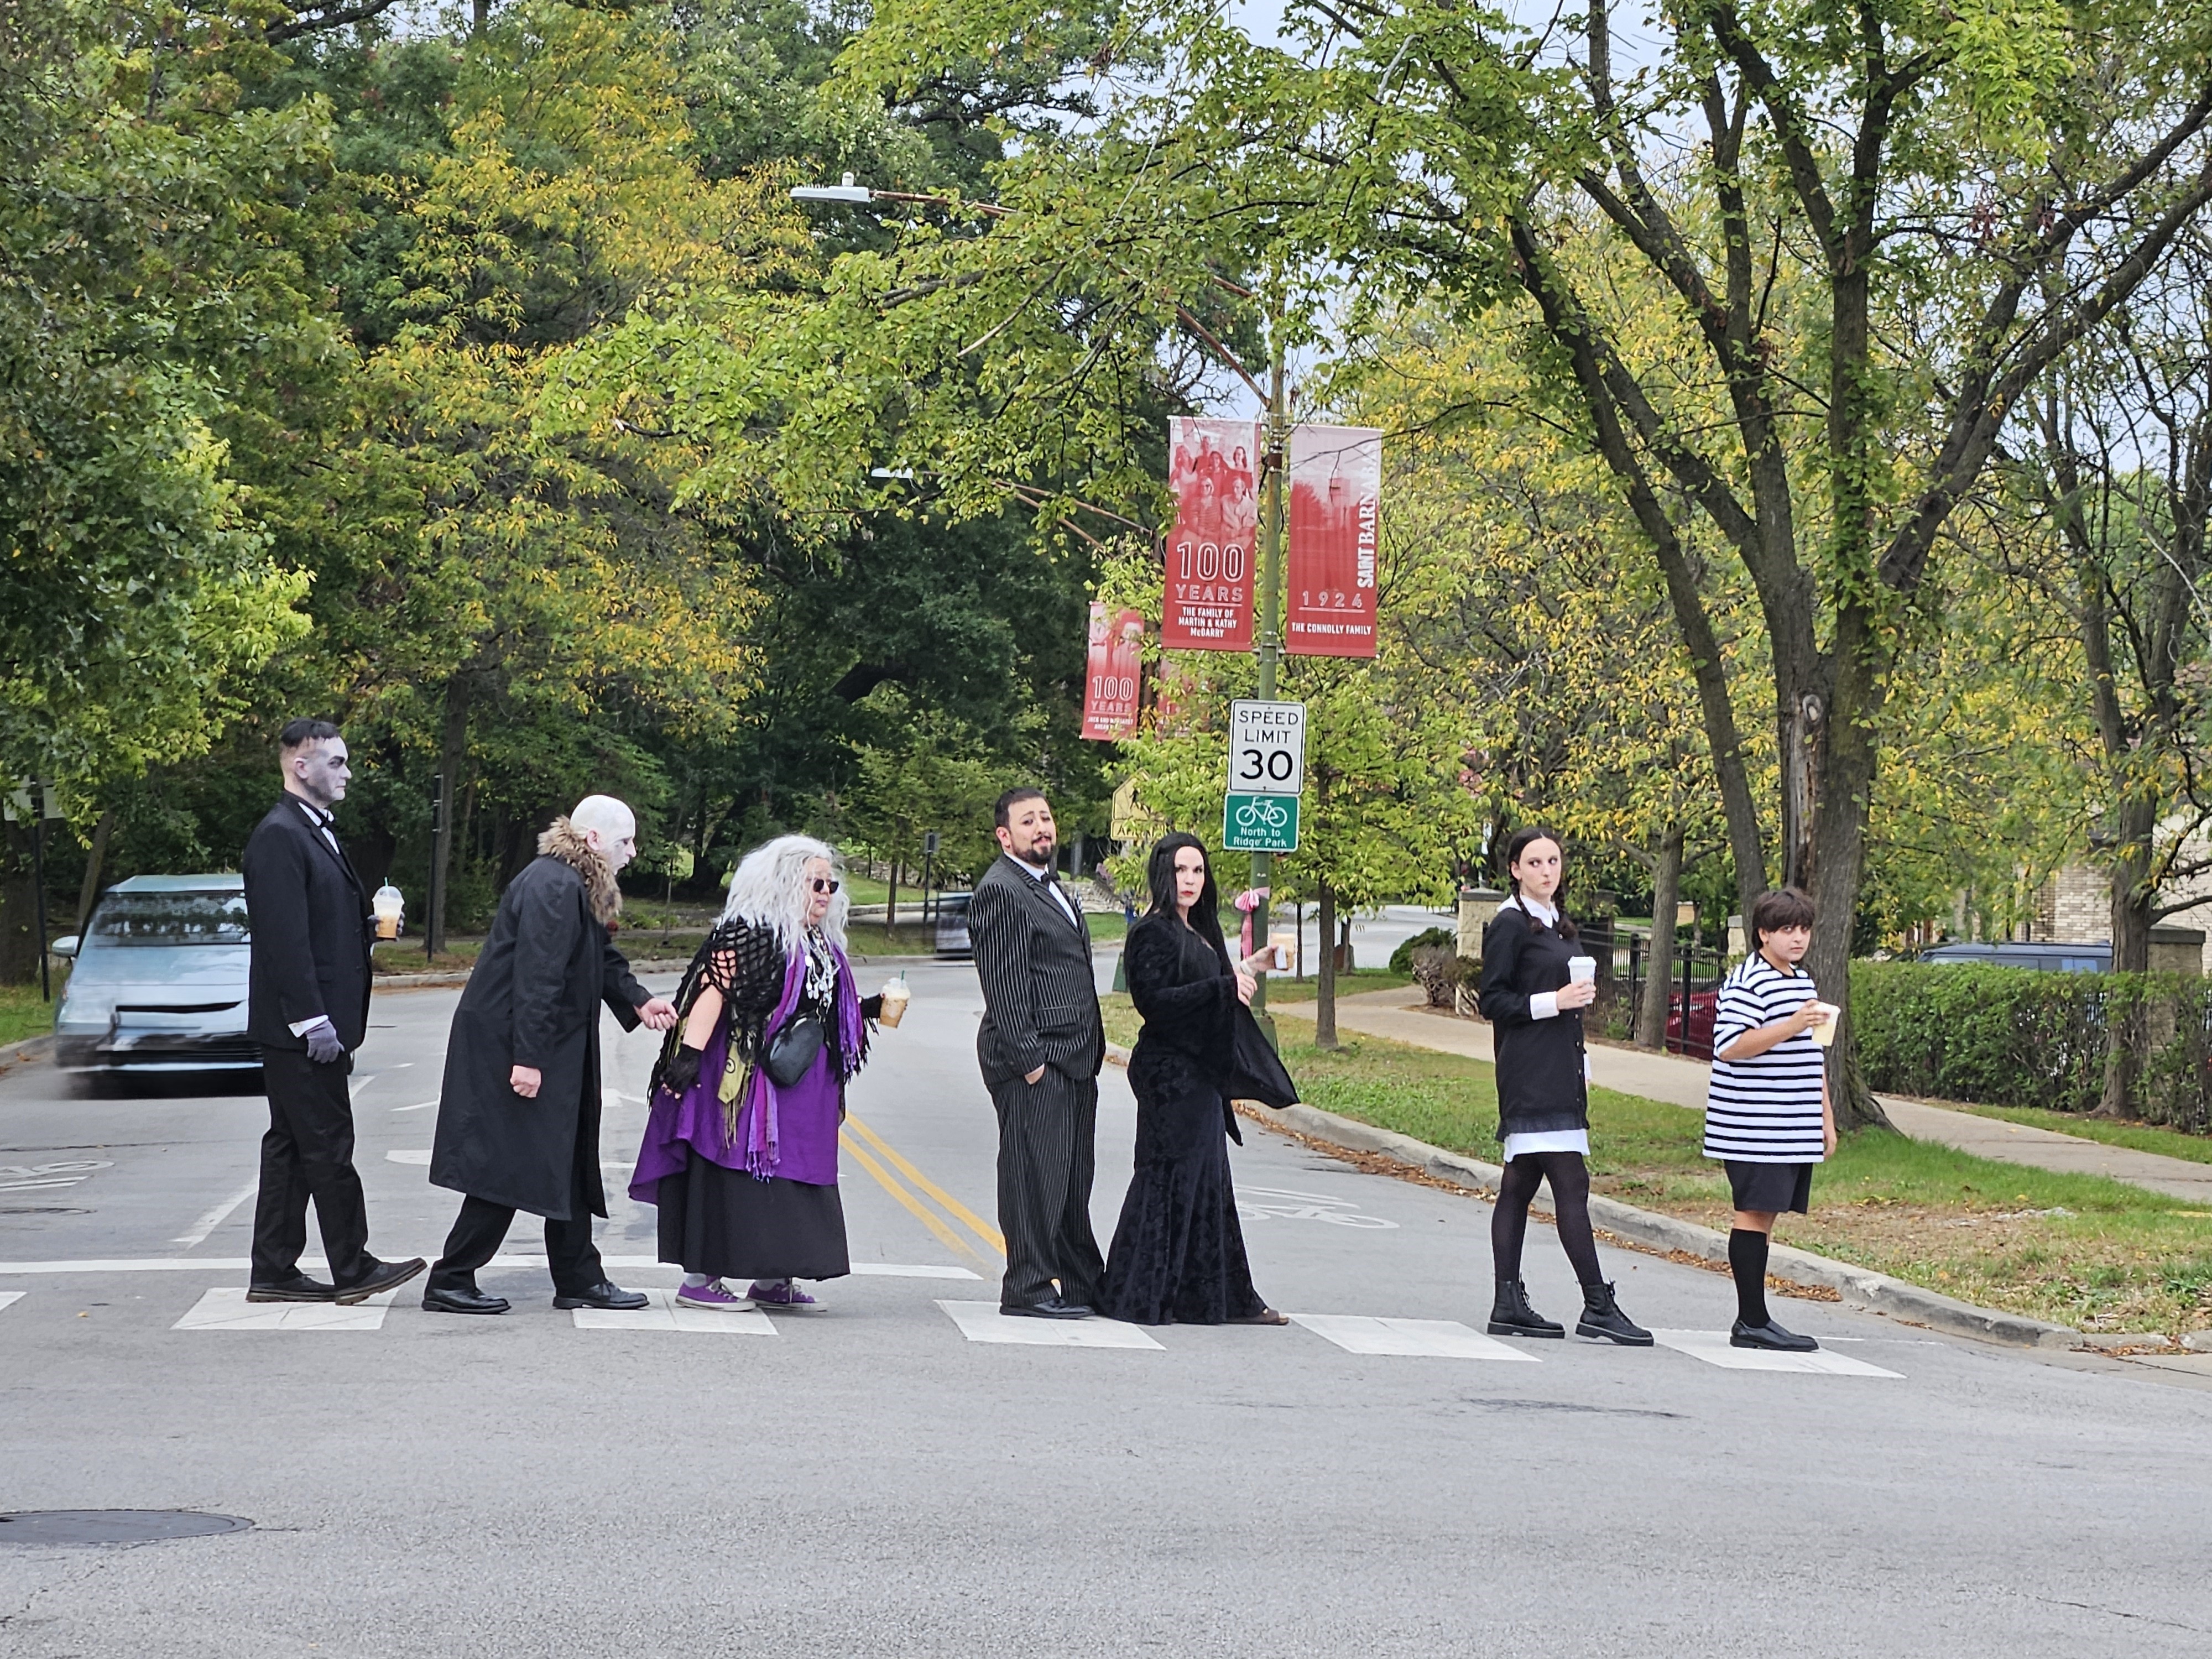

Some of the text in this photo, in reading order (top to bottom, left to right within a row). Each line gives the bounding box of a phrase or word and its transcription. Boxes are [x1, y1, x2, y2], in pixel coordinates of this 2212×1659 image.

[1177, 541, 1244, 582] 100
[1357, 547, 1374, 588] SAINT
[1176, 583, 1243, 602] YEARS
[1302, 591, 1363, 608] 1924
[1182, 606, 1234, 618] THE FAMILY OF
[1178, 616, 1237, 629] MARTIN & KATHY
[1291, 622, 1371, 635] THE CONNOLLY FAMILY
[1092, 676, 1134, 701] 100
[1091, 700, 1131, 713] YEARS
[1239, 710, 1298, 725] SPEED
[1244, 729, 1291, 743] LIMIT
[1239, 749, 1293, 781] 30
[1240, 826, 1281, 837] North to
[1233, 836, 1287, 848] Ridge Park
